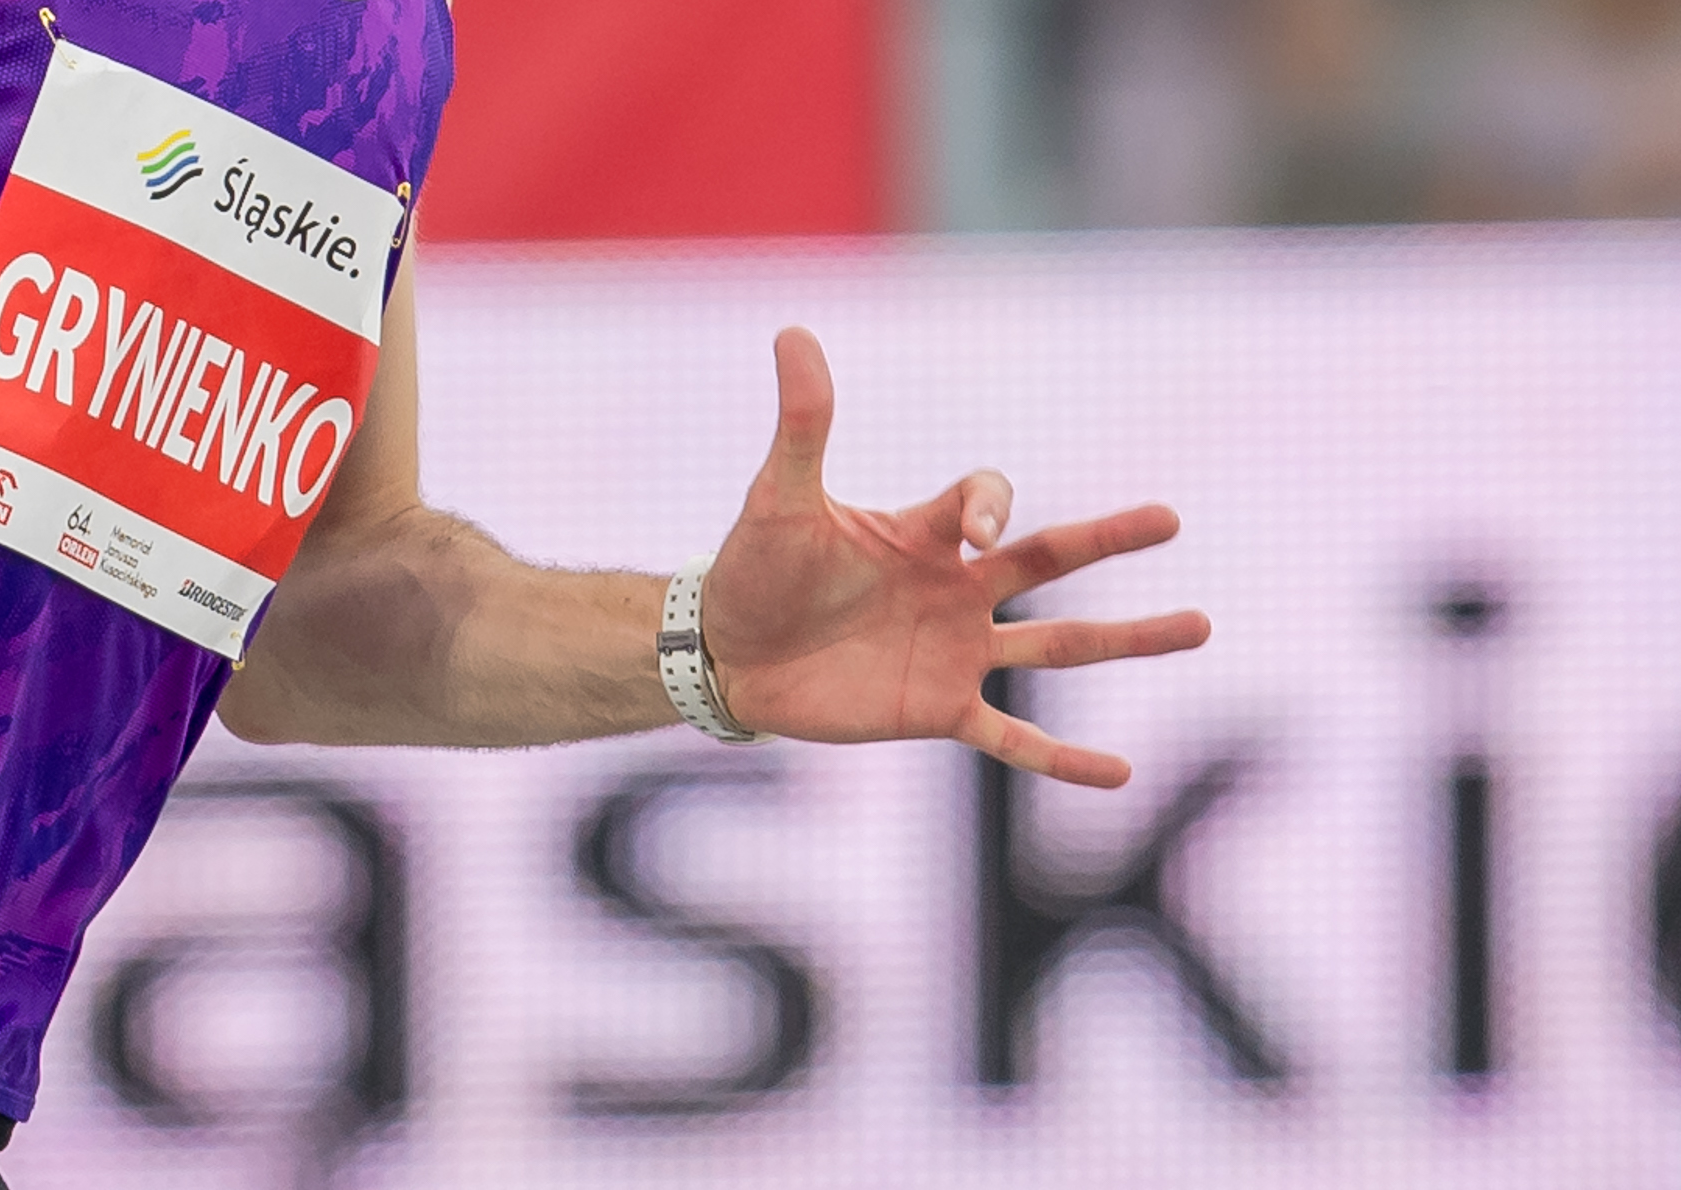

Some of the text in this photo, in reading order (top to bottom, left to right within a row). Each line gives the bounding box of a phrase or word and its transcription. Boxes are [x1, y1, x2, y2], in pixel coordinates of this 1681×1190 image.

[213, 157, 360, 279] Śląskie.
[67, 504, 92, 536] 64.
[59, 535, 98, 567] ORLEN
